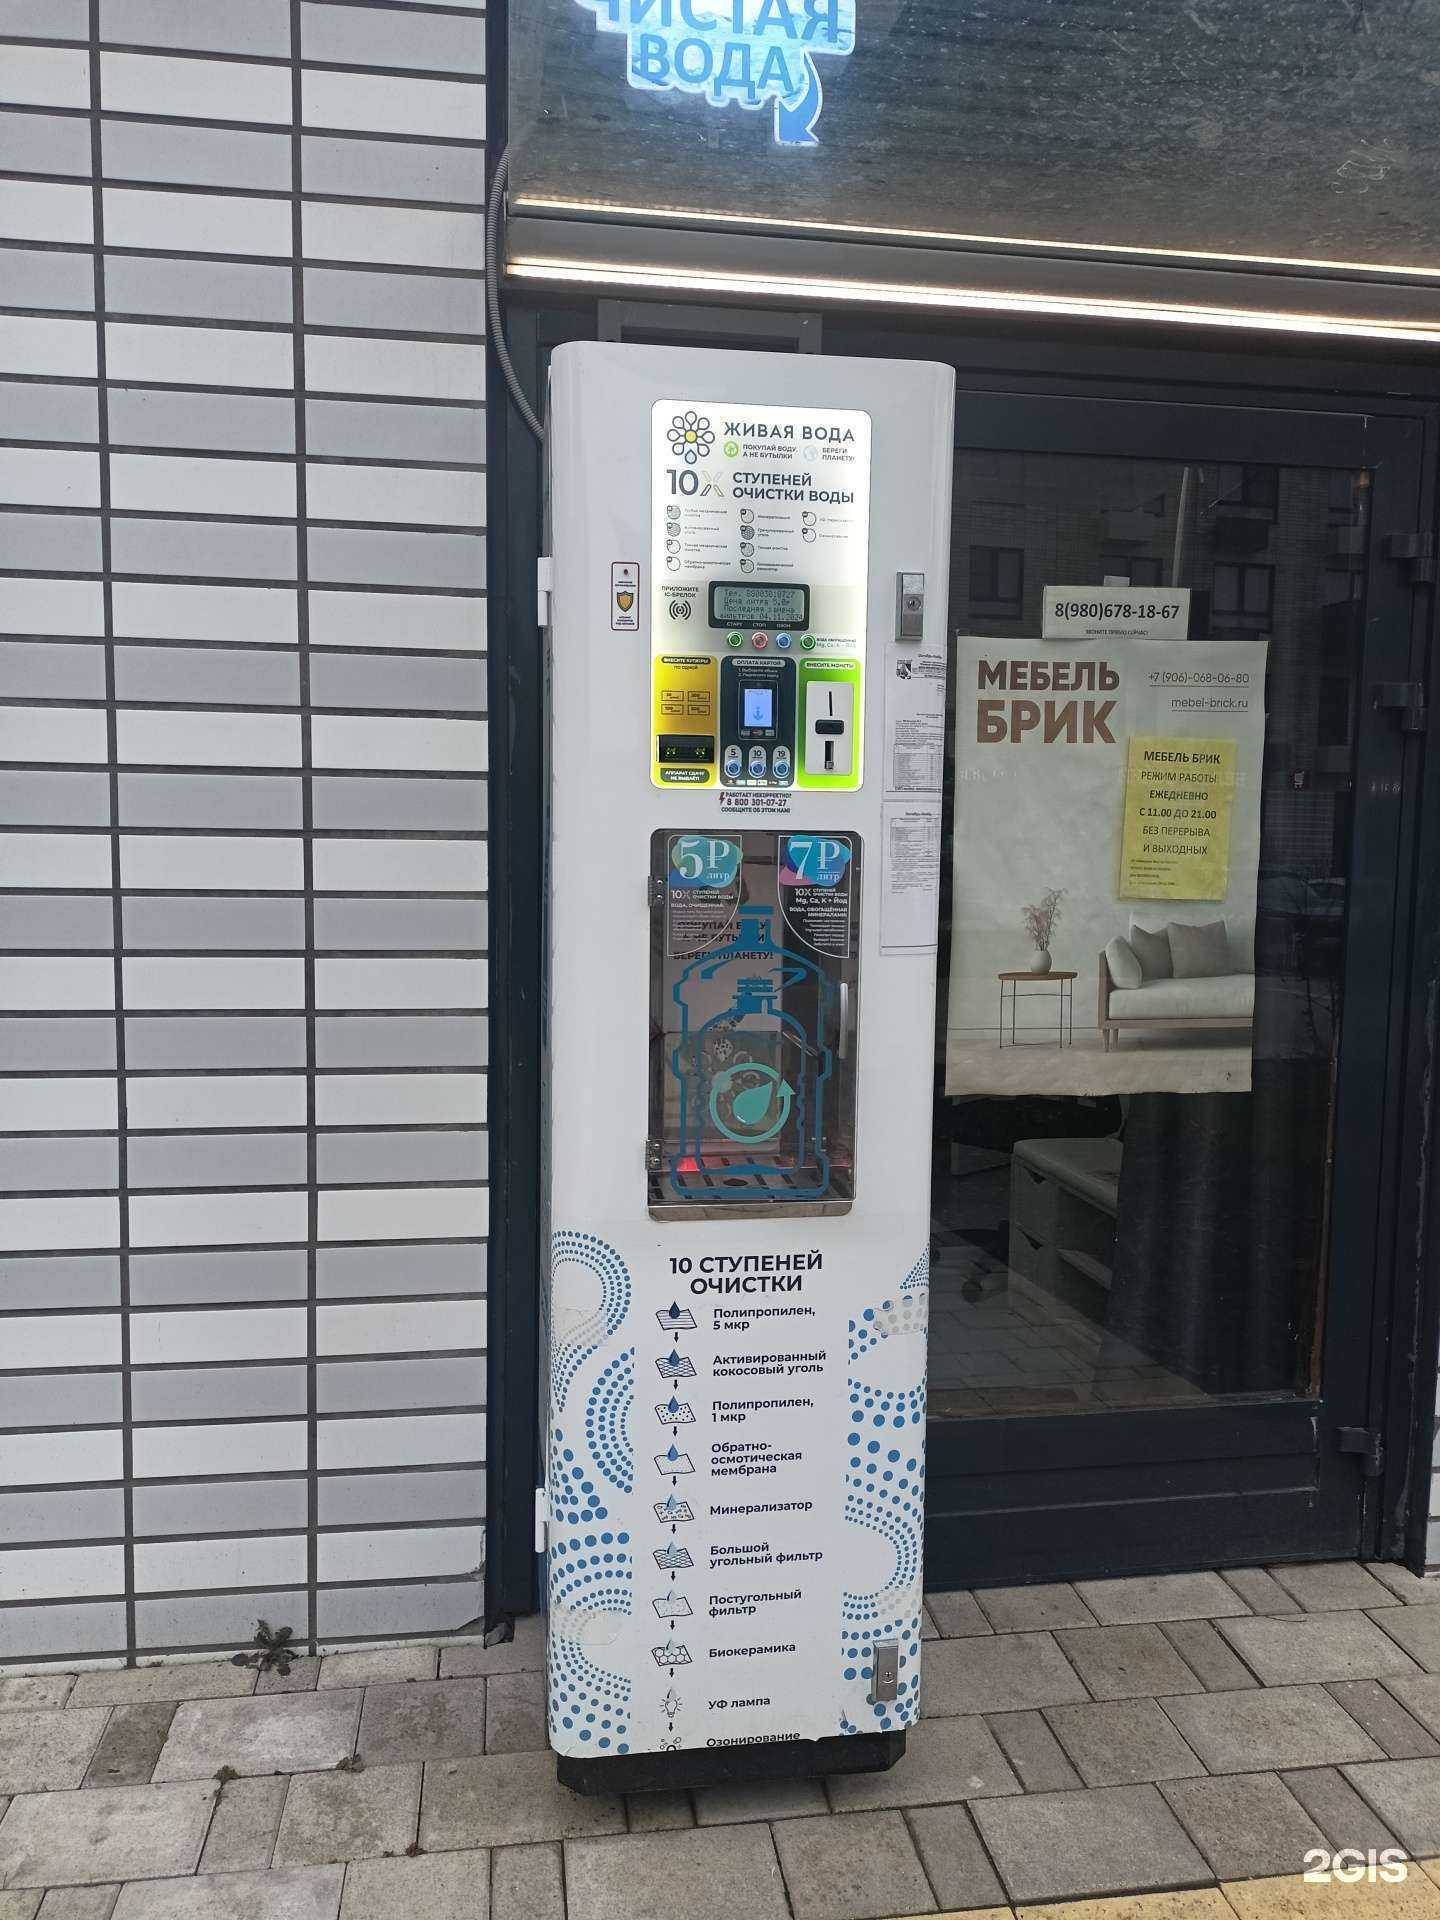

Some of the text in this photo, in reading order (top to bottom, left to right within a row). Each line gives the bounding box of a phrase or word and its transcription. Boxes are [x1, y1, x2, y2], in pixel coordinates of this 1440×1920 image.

[608, 0, 838, 43] ИСТАЯ
[638, 33, 794, 99] ВОДА
[724, 422, 855, 443] ЖИВАЯ ВОДА
[743, 444, 777, 452] ПОКУПАЙ
[759, 452, 793, 460] БУТЫЛКИ
[733, 471, 812, 486] СТУПЕНЕЙ
[733, 487, 854, 505] ОЧИСТКИ ВОДЫ
[1055, 602, 1179, 620] 8(980)678-18-67
[978, 660, 1120, 691] МЕБЕЛЬ
[1149, 671, 1250, 684] +7 (906)-068-06-80
[1171, 696, 1249, 709] mebel-brick.ru
[976, 699, 1120, 744] БРИК
[1144, 750, 1221, 764] МЕБЕЛЬ БРИК
[1141, 771, 1217, 784] РЕЖИМ РАБОТЫ
[1149, 789, 1209, 801] ЕЖЕДНЕВНО
[752, 799, 787, 807] 301-07-27
[1139, 808, 1217, 819] С 11.00 ДО 21.00
[1142, 826, 1211, 837] БЕЗ ПЕРЕРЫВА
[1143, 844, 1208, 855] И ВЫХОДНЫХ
[679, 840, 703, 879] 5
[790, 841, 812, 880] 7
[706, 872, 730, 881] литр
[817, 873, 840, 883] литр
[833, 897, 848, 905] Йод
[669, 1249, 823, 1274] 10 СТУПЕНЕЙ
[690, 1275, 803, 1295] ОЧИСТКИ
[713, 1306, 816, 1319] Полипропилен,
[713, 1321, 750, 1331] 5 мкр
[713, 1351, 827, 1365] Активированный
[713, 1364, 824, 1377] кокосовый уголь
[712, 1398, 814, 1411] Полипропилен,
[711, 1413, 746, 1423] 1 мкр
[711, 1442, 772, 1454] Обратно-
[711, 1452, 802, 1465] осмотическая
[711, 1465, 777, 1477] мембрана
[710, 1501, 813, 1515] Минерализатор
[710, 1542, 769, 1555] Большой
[710, 1552, 823, 1569] угольный фильтр
[709, 1589, 802, 1606] Постугольный
[708, 1605, 756, 1618] фильтр
[709, 1643, 796, 1658] Биокерамика
[708, 1697, 771, 1710] УФ лампа
[706, 1732, 801, 1747] Озонирование
